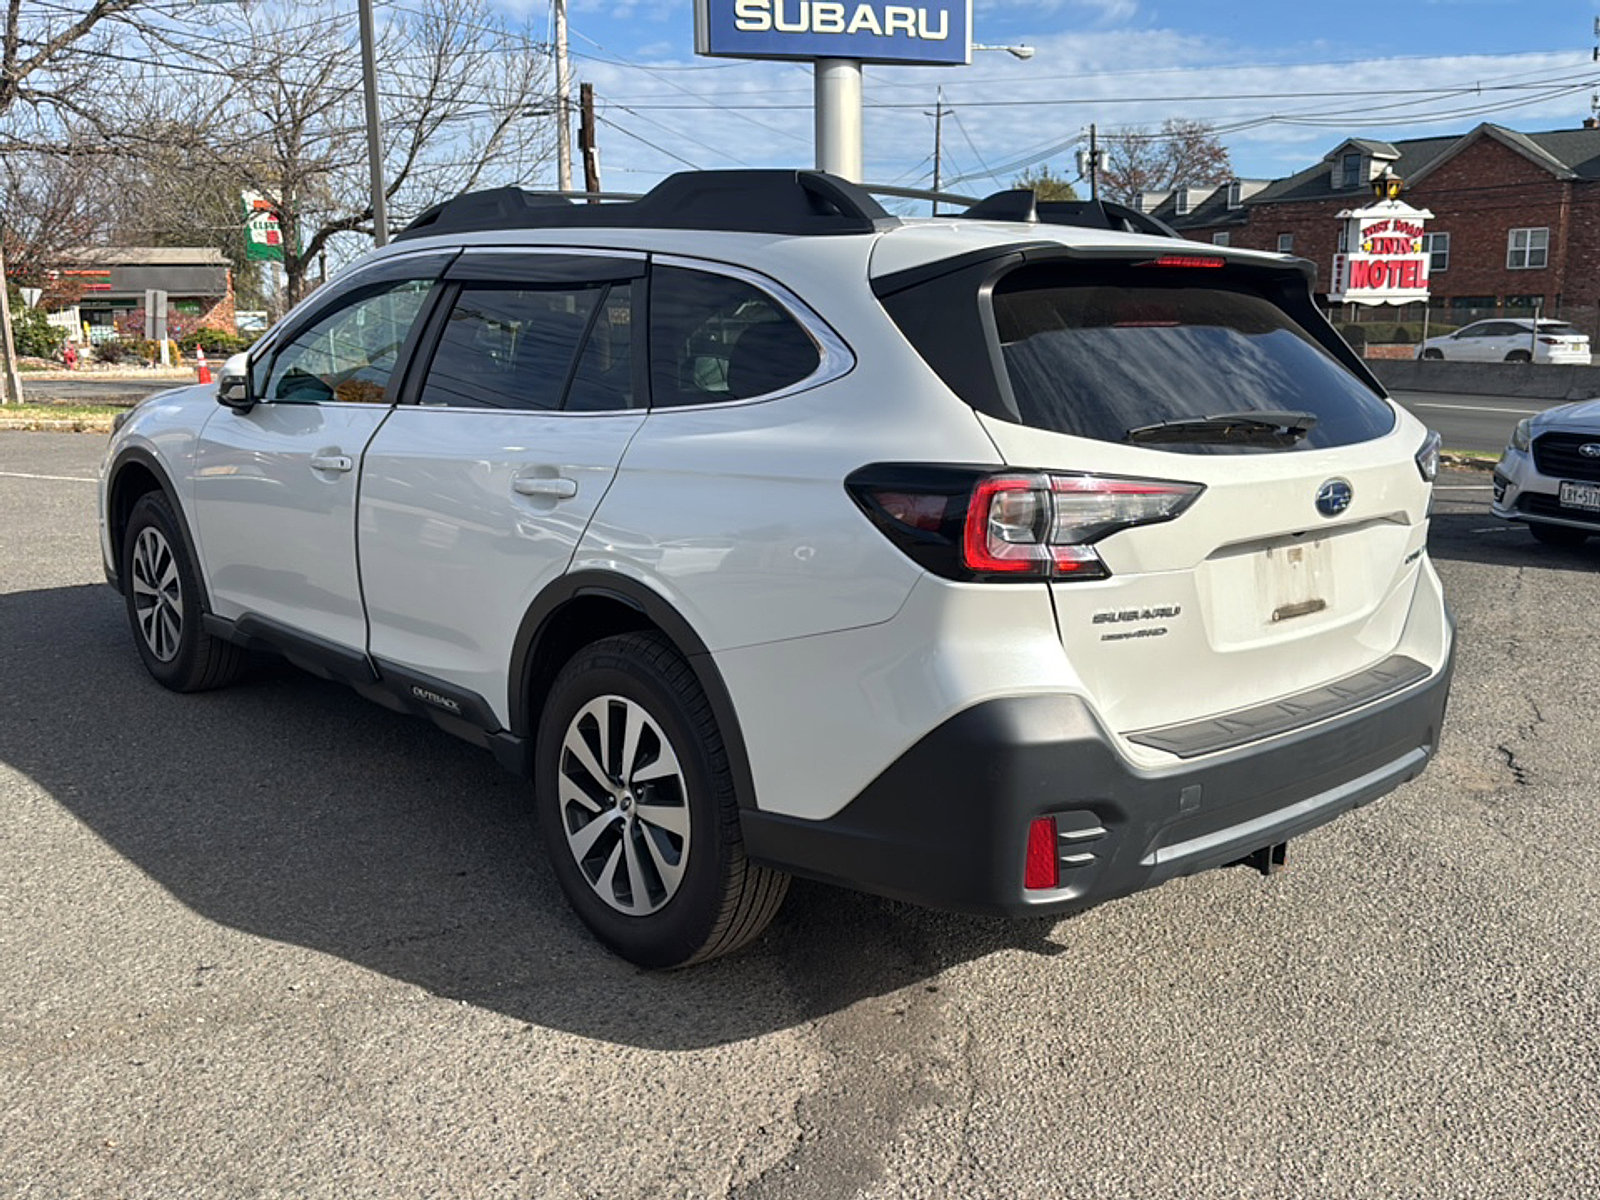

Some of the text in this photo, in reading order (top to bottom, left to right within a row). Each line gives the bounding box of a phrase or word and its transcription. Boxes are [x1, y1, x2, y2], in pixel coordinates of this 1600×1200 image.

[734, 0, 948, 40] SUBARU
[1370, 237, 1412, 254] INN
[1349, 259, 1431, 289] MOTEL
[1092, 606, 1181, 624] SUBARU
[413, 686, 461, 714] OUTBACK
